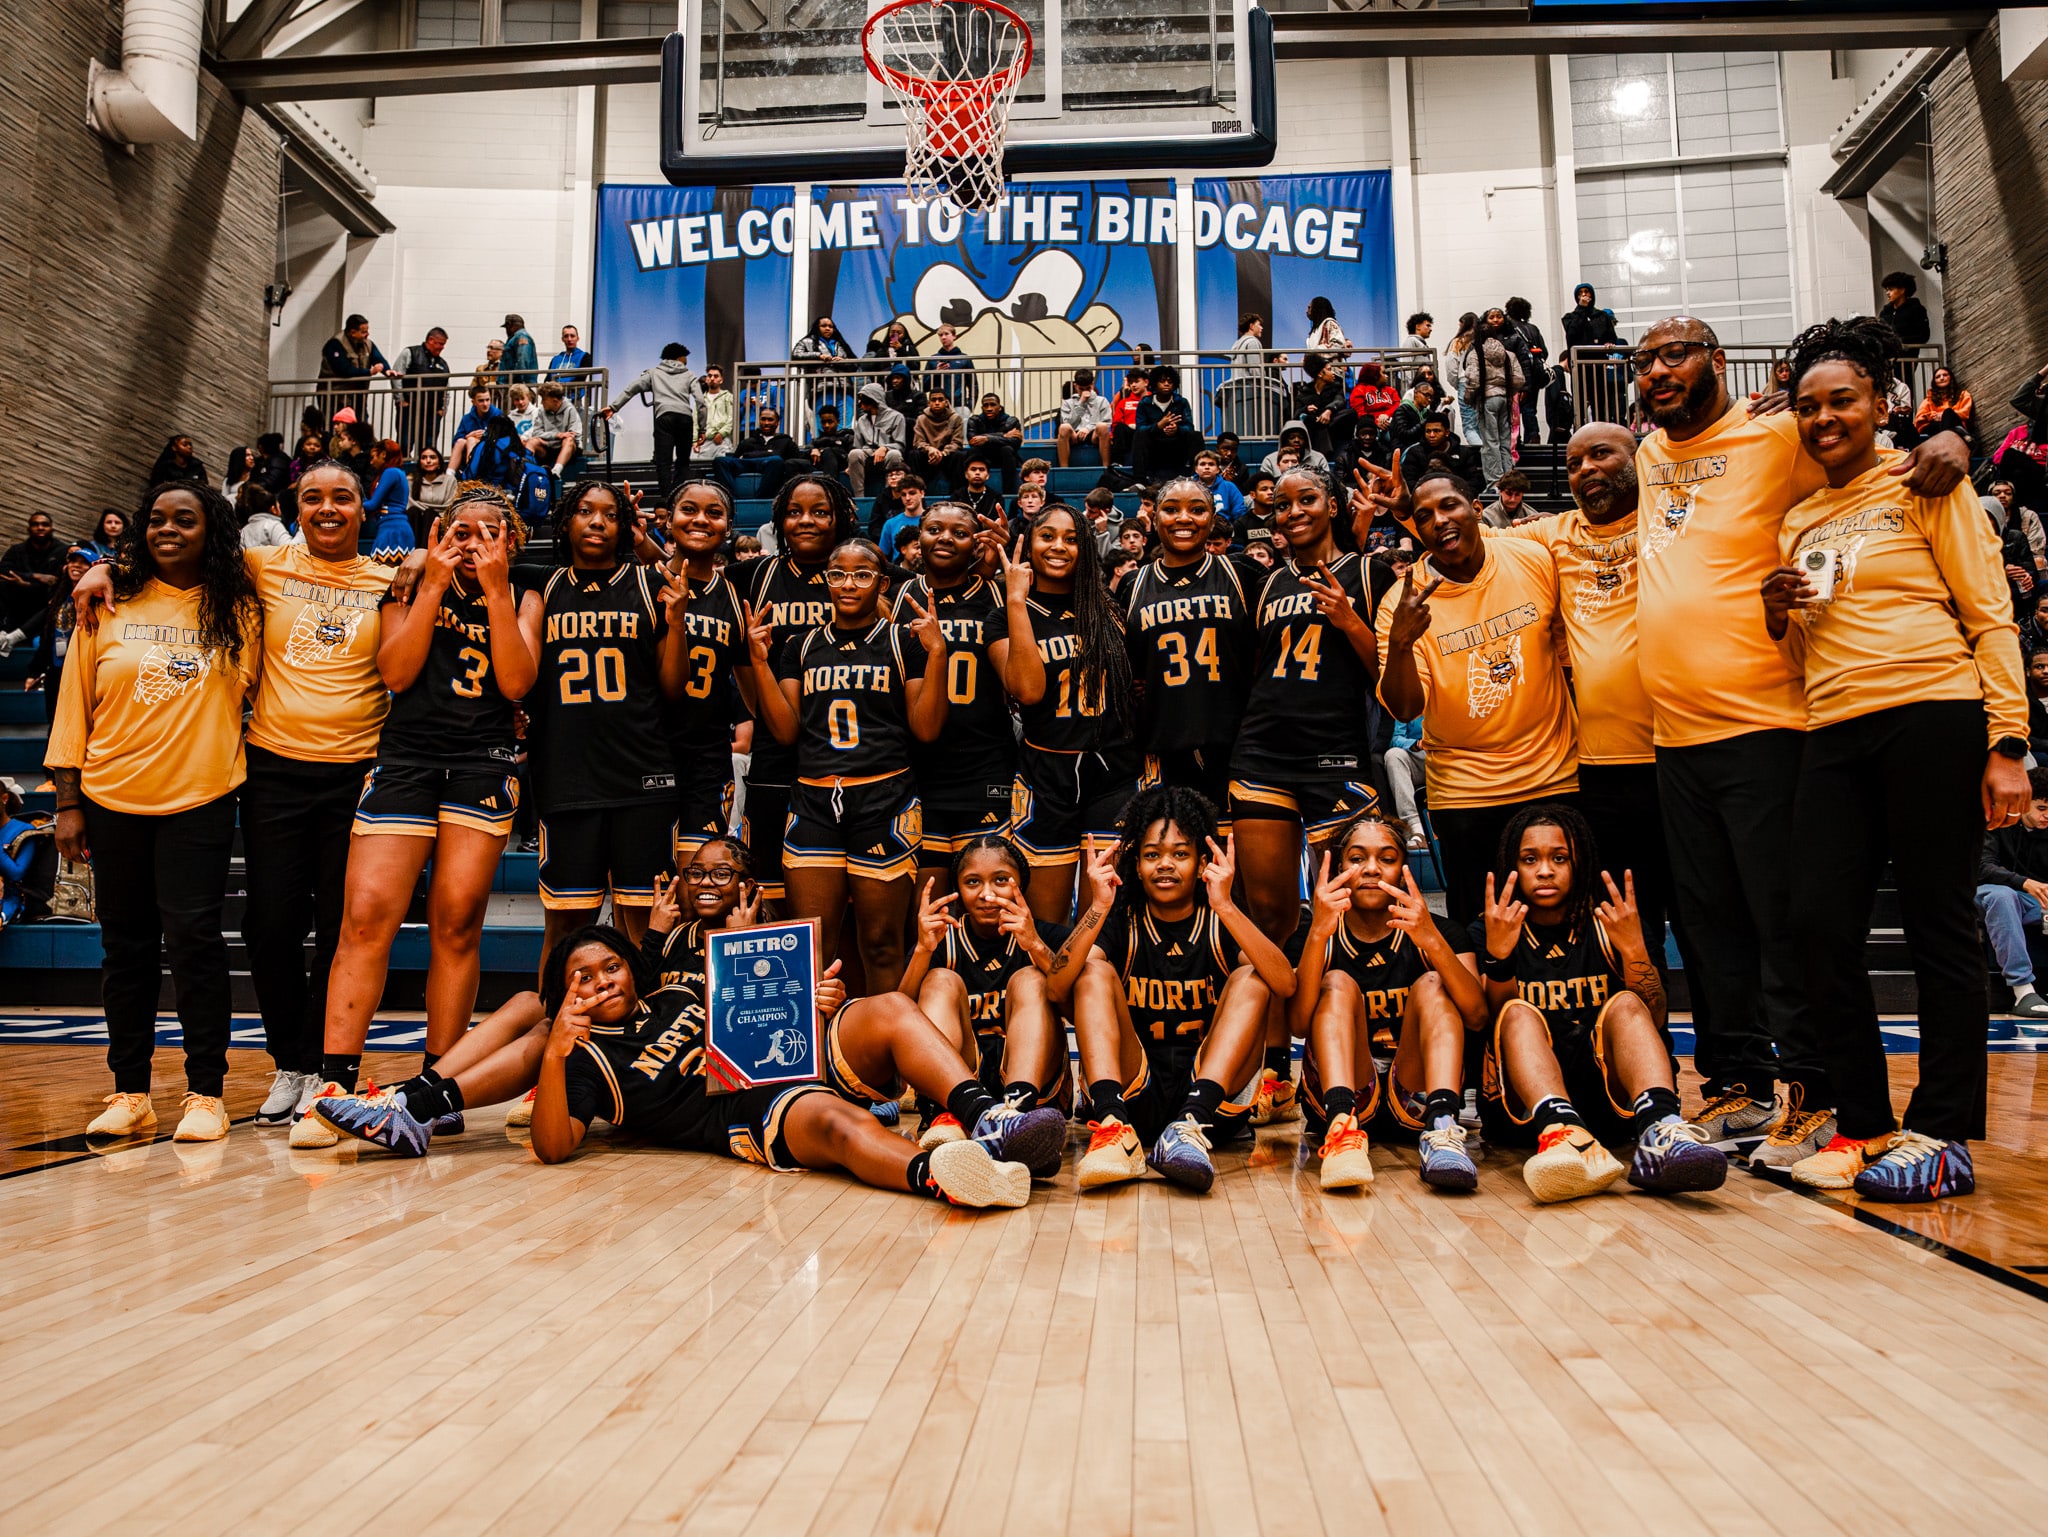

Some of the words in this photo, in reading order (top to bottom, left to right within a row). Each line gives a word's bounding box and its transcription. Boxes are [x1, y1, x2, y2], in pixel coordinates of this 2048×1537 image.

[630, 199, 881, 270] WELCOME
[897, 196, 962, 244] TO
[984, 194, 1079, 242] THE
[1096, 195, 1364, 260] BIRDCAGE
[281, 577, 331, 604] NORTH
[334, 587, 384, 611] VIKING
[1140, 594, 1233, 632] NORTH
[123, 623, 178, 643] NORTH
[435, 605, 490, 644] NOR
[546, 611, 640, 644] NORTH
[684, 612, 732, 648] RTH
[771, 601, 837, 627] NORT
[1436, 623, 1485, 657] NORTH
[1485, 601, 1541, 640] VIKINGS
[1037, 634, 1084, 665] NOR
[1157, 627, 1222, 688] 34
[1272, 623, 1323, 682] 14
[451, 646, 490, 699] 3
[557, 647, 628, 705] 20
[684, 645, 717, 699] 3
[803, 664, 892, 697] NORTH
[947, 650, 978, 705] 0
[826, 698, 861, 750] 0
[723, 933, 799, 957] METRO
[737, 1011, 788, 1025] CHAMPION
